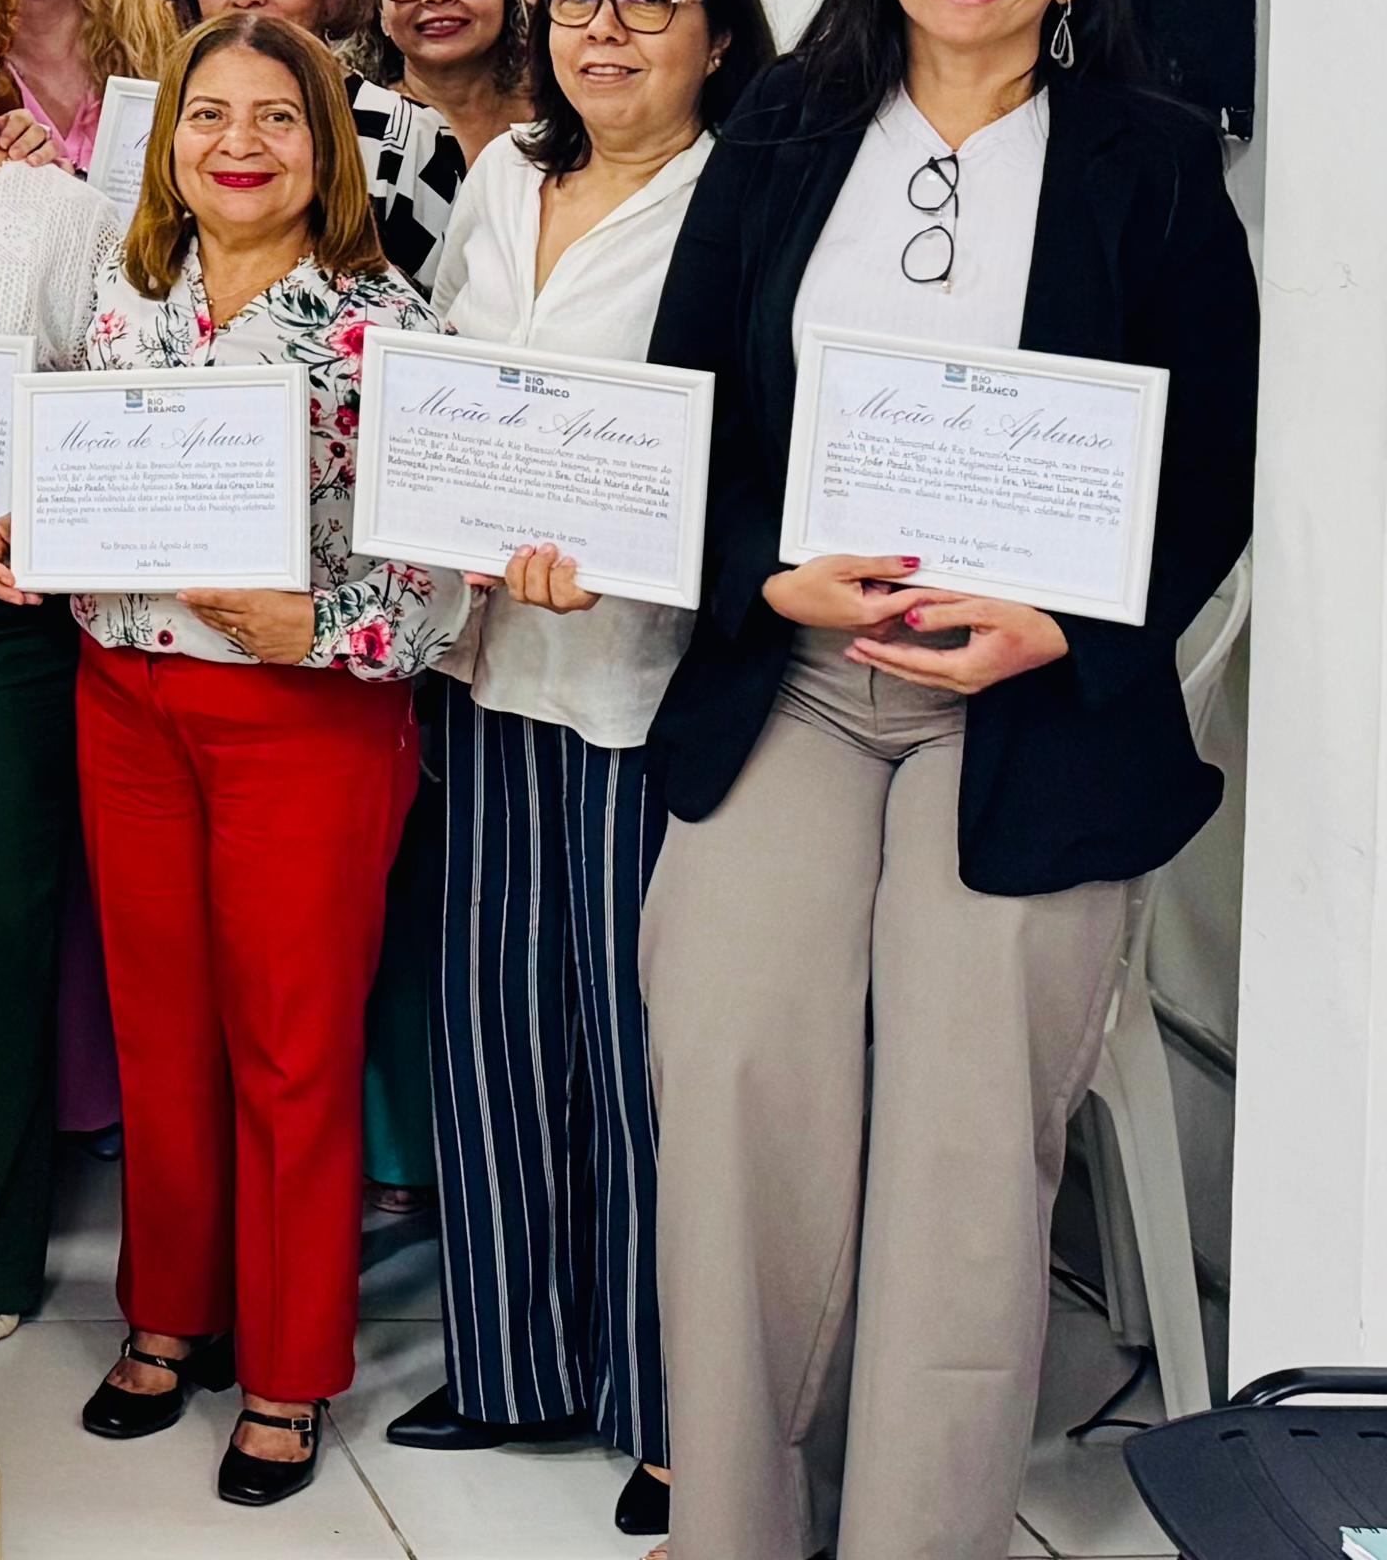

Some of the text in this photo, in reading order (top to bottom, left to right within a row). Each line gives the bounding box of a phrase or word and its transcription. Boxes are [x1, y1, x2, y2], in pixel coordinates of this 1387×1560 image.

[525, 376, 544, 385] RIO
[972, 375, 991, 384] RIO
[525, 385, 569, 398] BRANCO
[971, 384, 1018, 397] BRANCO
[147, 398, 163, 406] RIO
[147, 405, 185, 413] BRANCO
[401, 386, 660, 448] Moção de Aplauso
[841, 387, 1112, 451] Moção de Aplauso
[46, 418, 264, 459] Moção de Aplauso
